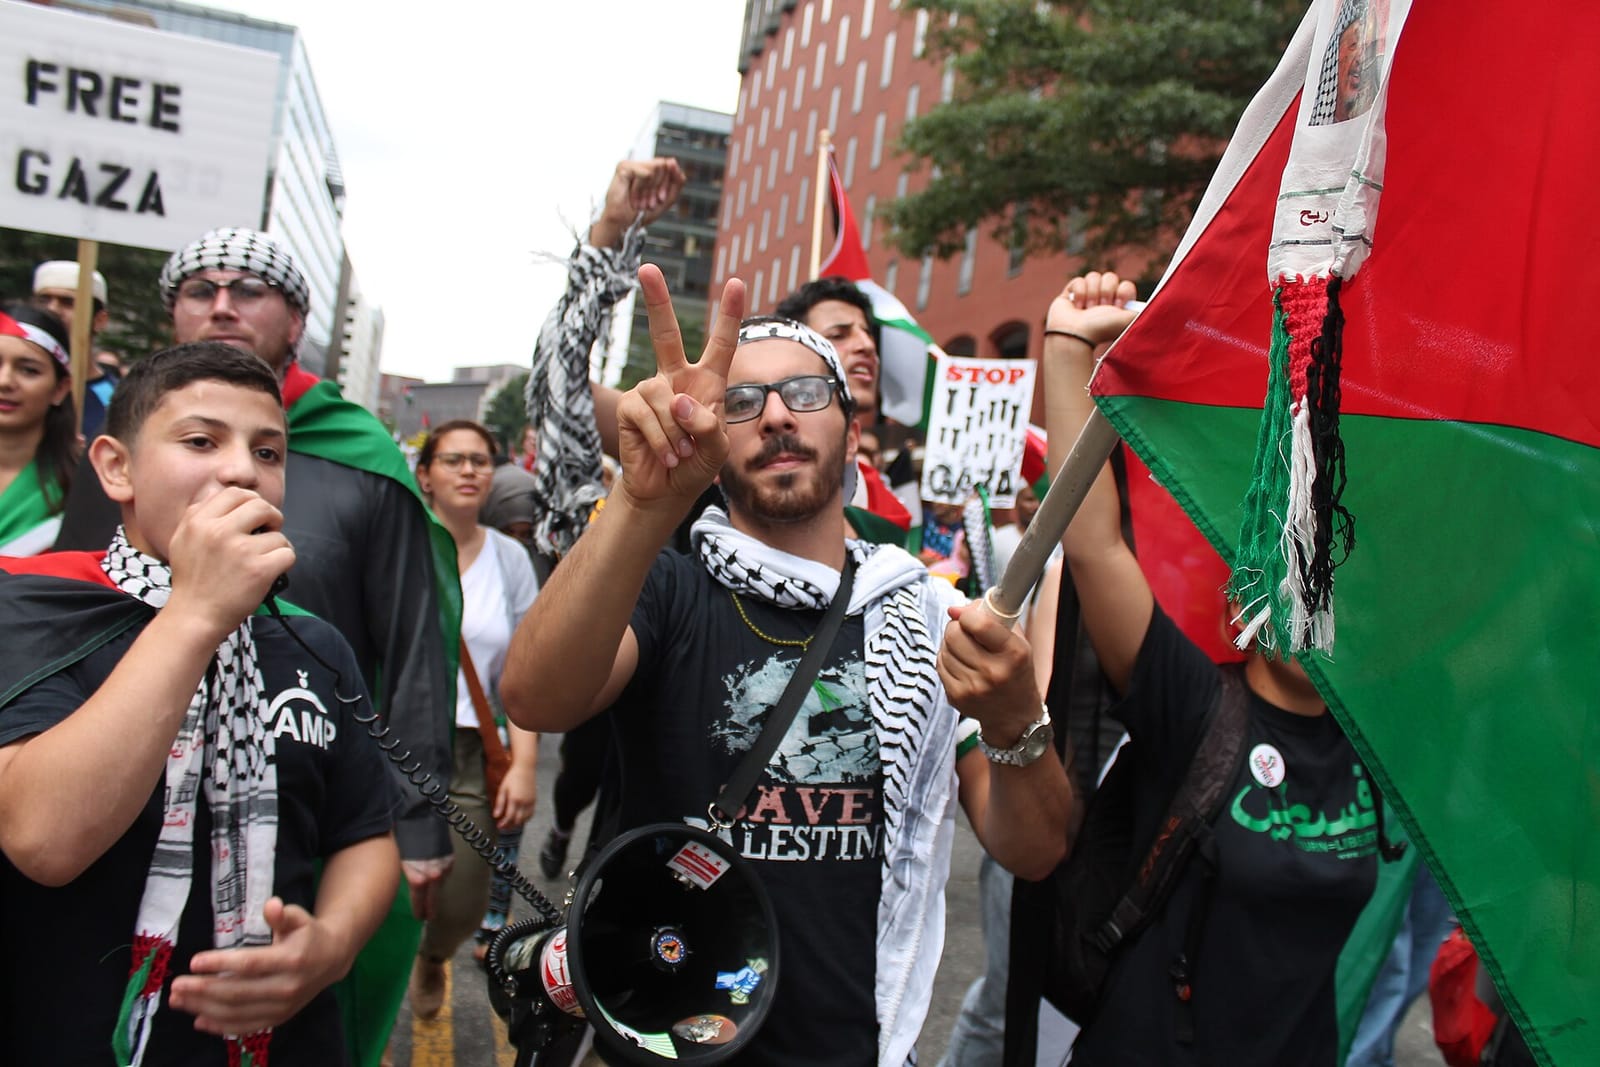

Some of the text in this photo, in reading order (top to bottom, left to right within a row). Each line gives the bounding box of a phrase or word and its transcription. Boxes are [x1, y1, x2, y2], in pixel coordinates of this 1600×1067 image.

[25, 58, 182, 134] FREE
[15, 148, 166, 217] GAZA
[946, 366, 1025, 385] STOP
[273, 706, 337, 750] AMP
